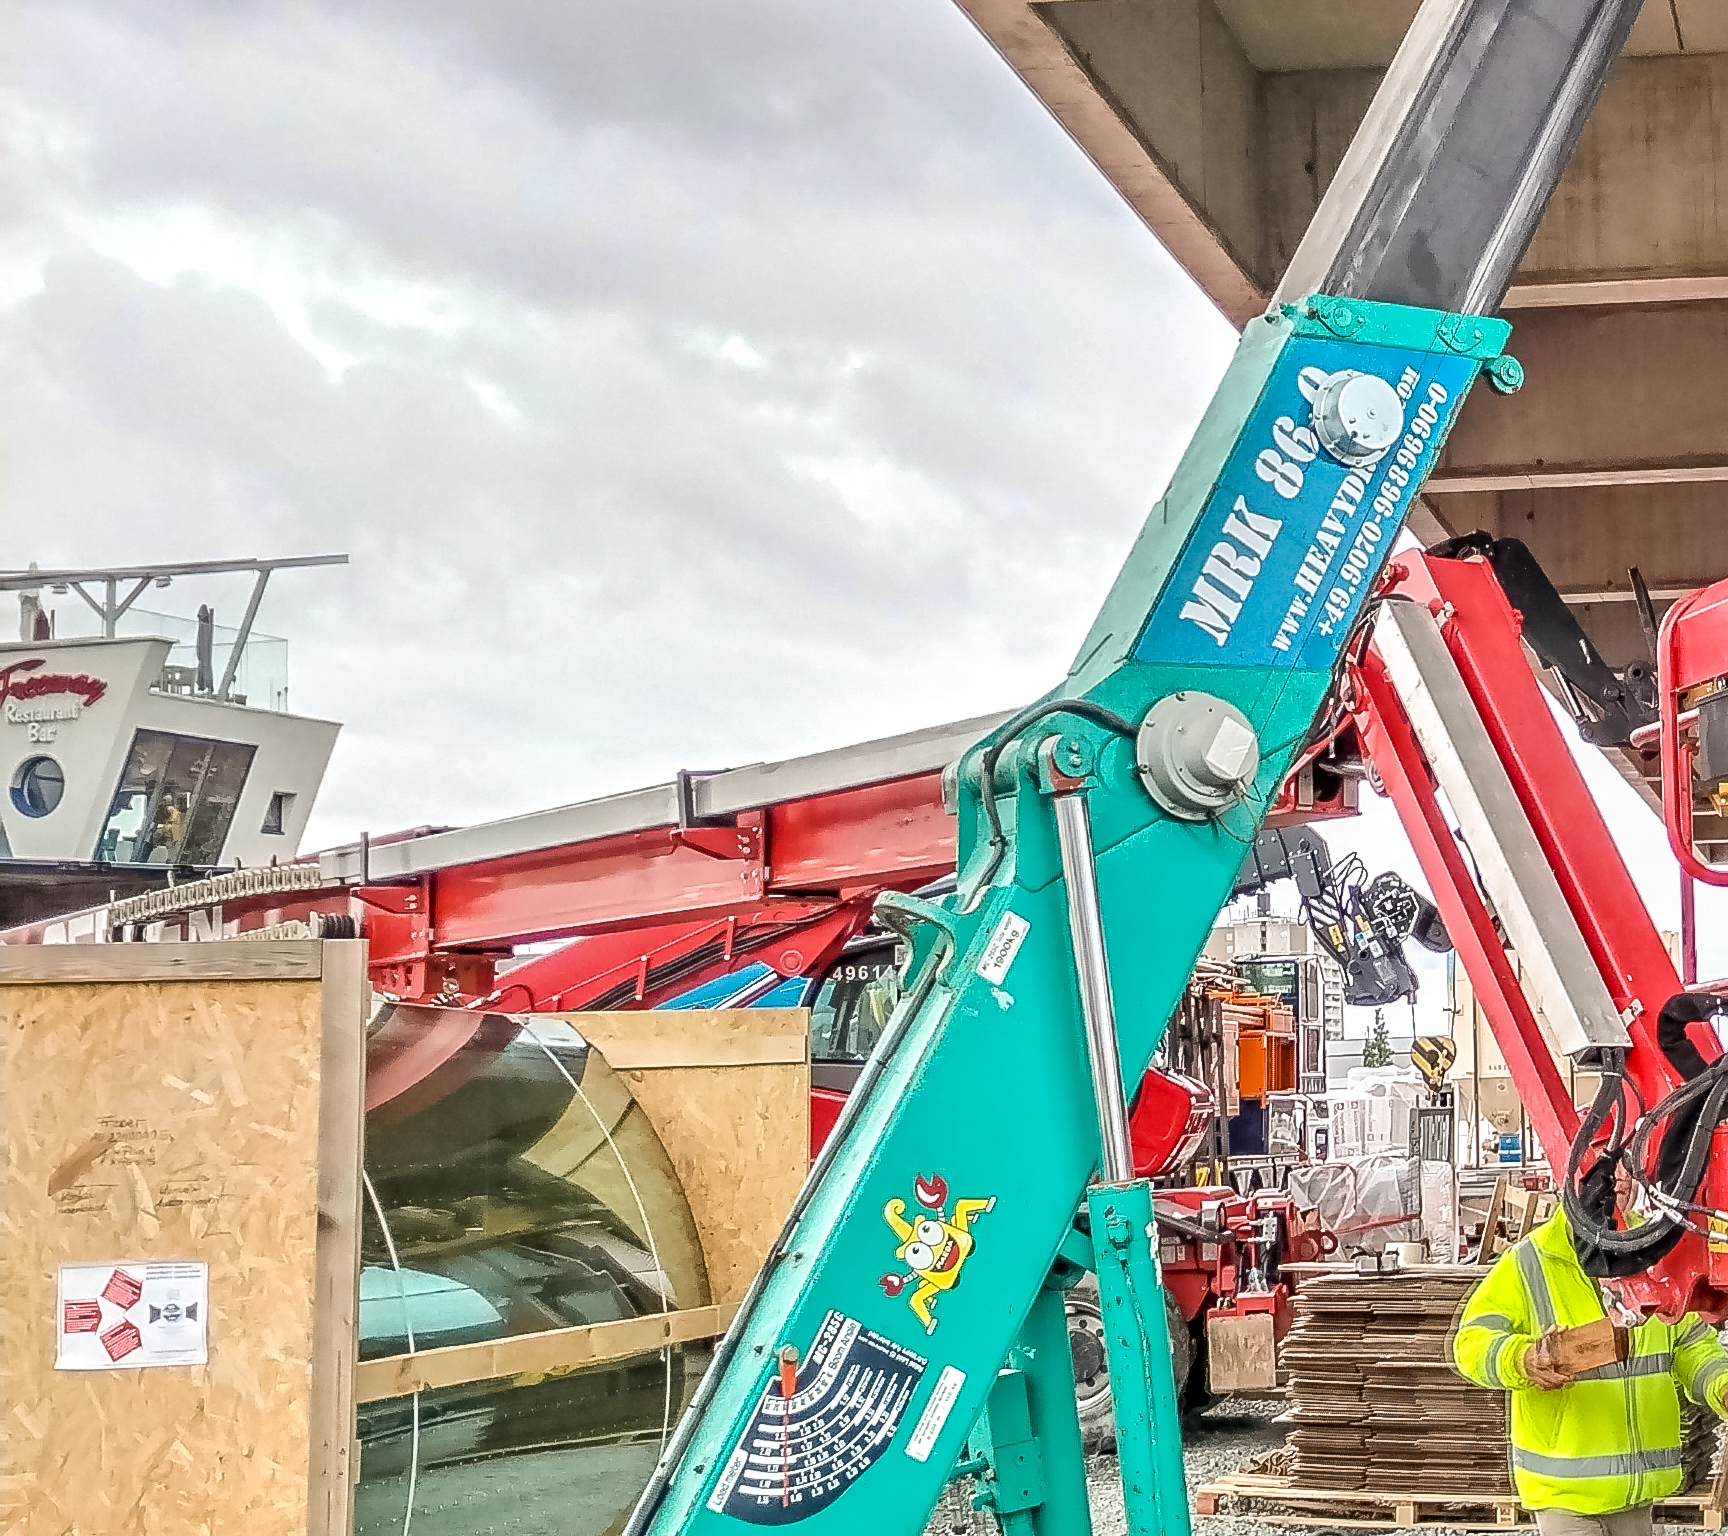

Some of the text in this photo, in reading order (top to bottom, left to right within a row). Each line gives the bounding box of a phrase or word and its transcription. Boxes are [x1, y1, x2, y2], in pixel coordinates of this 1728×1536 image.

[1179, 494, 1283, 646] MRK
[5, 703, 80, 723] Restaurant
[27, 723, 57, 743] Bar
[712, 1457, 743, 1506] Load meter
